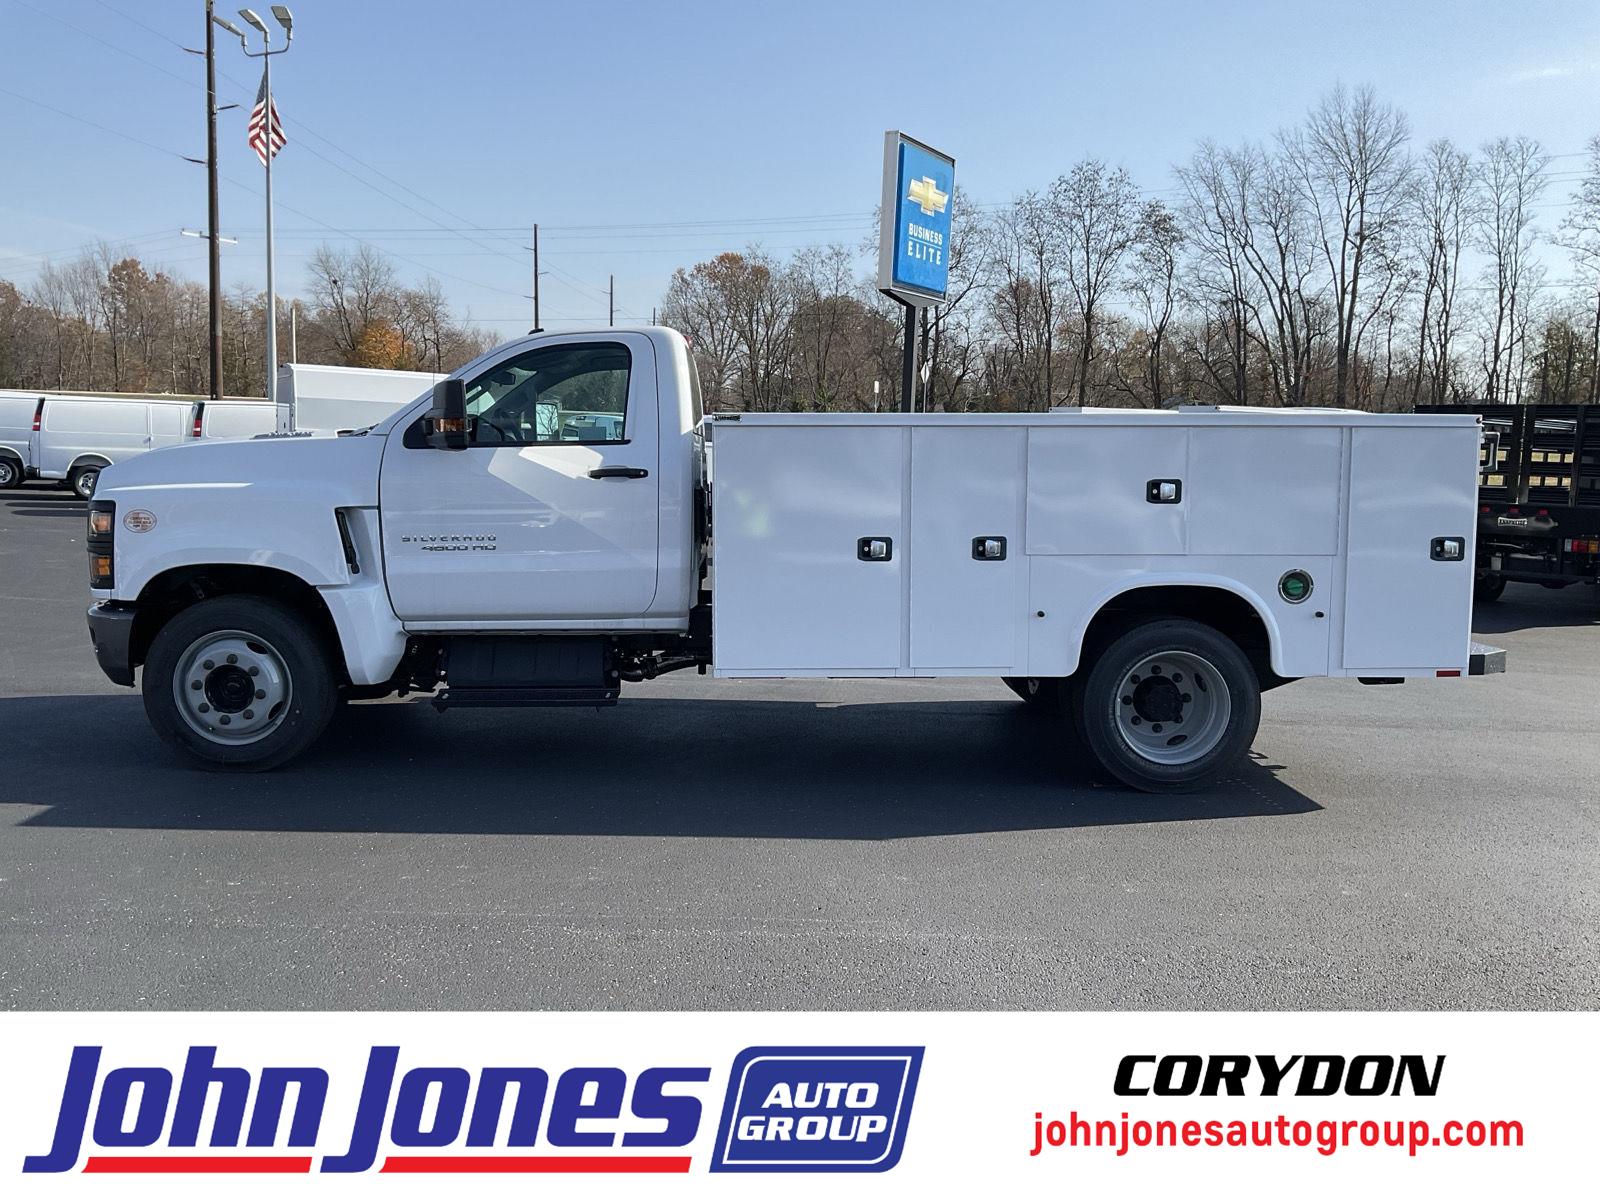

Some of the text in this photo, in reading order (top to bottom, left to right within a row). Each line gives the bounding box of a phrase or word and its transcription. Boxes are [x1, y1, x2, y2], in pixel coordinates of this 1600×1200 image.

[909, 223, 943, 246] BUSINESS
[908, 241, 942, 265] ELITE
[402, 534, 497, 542] SILVERADO
